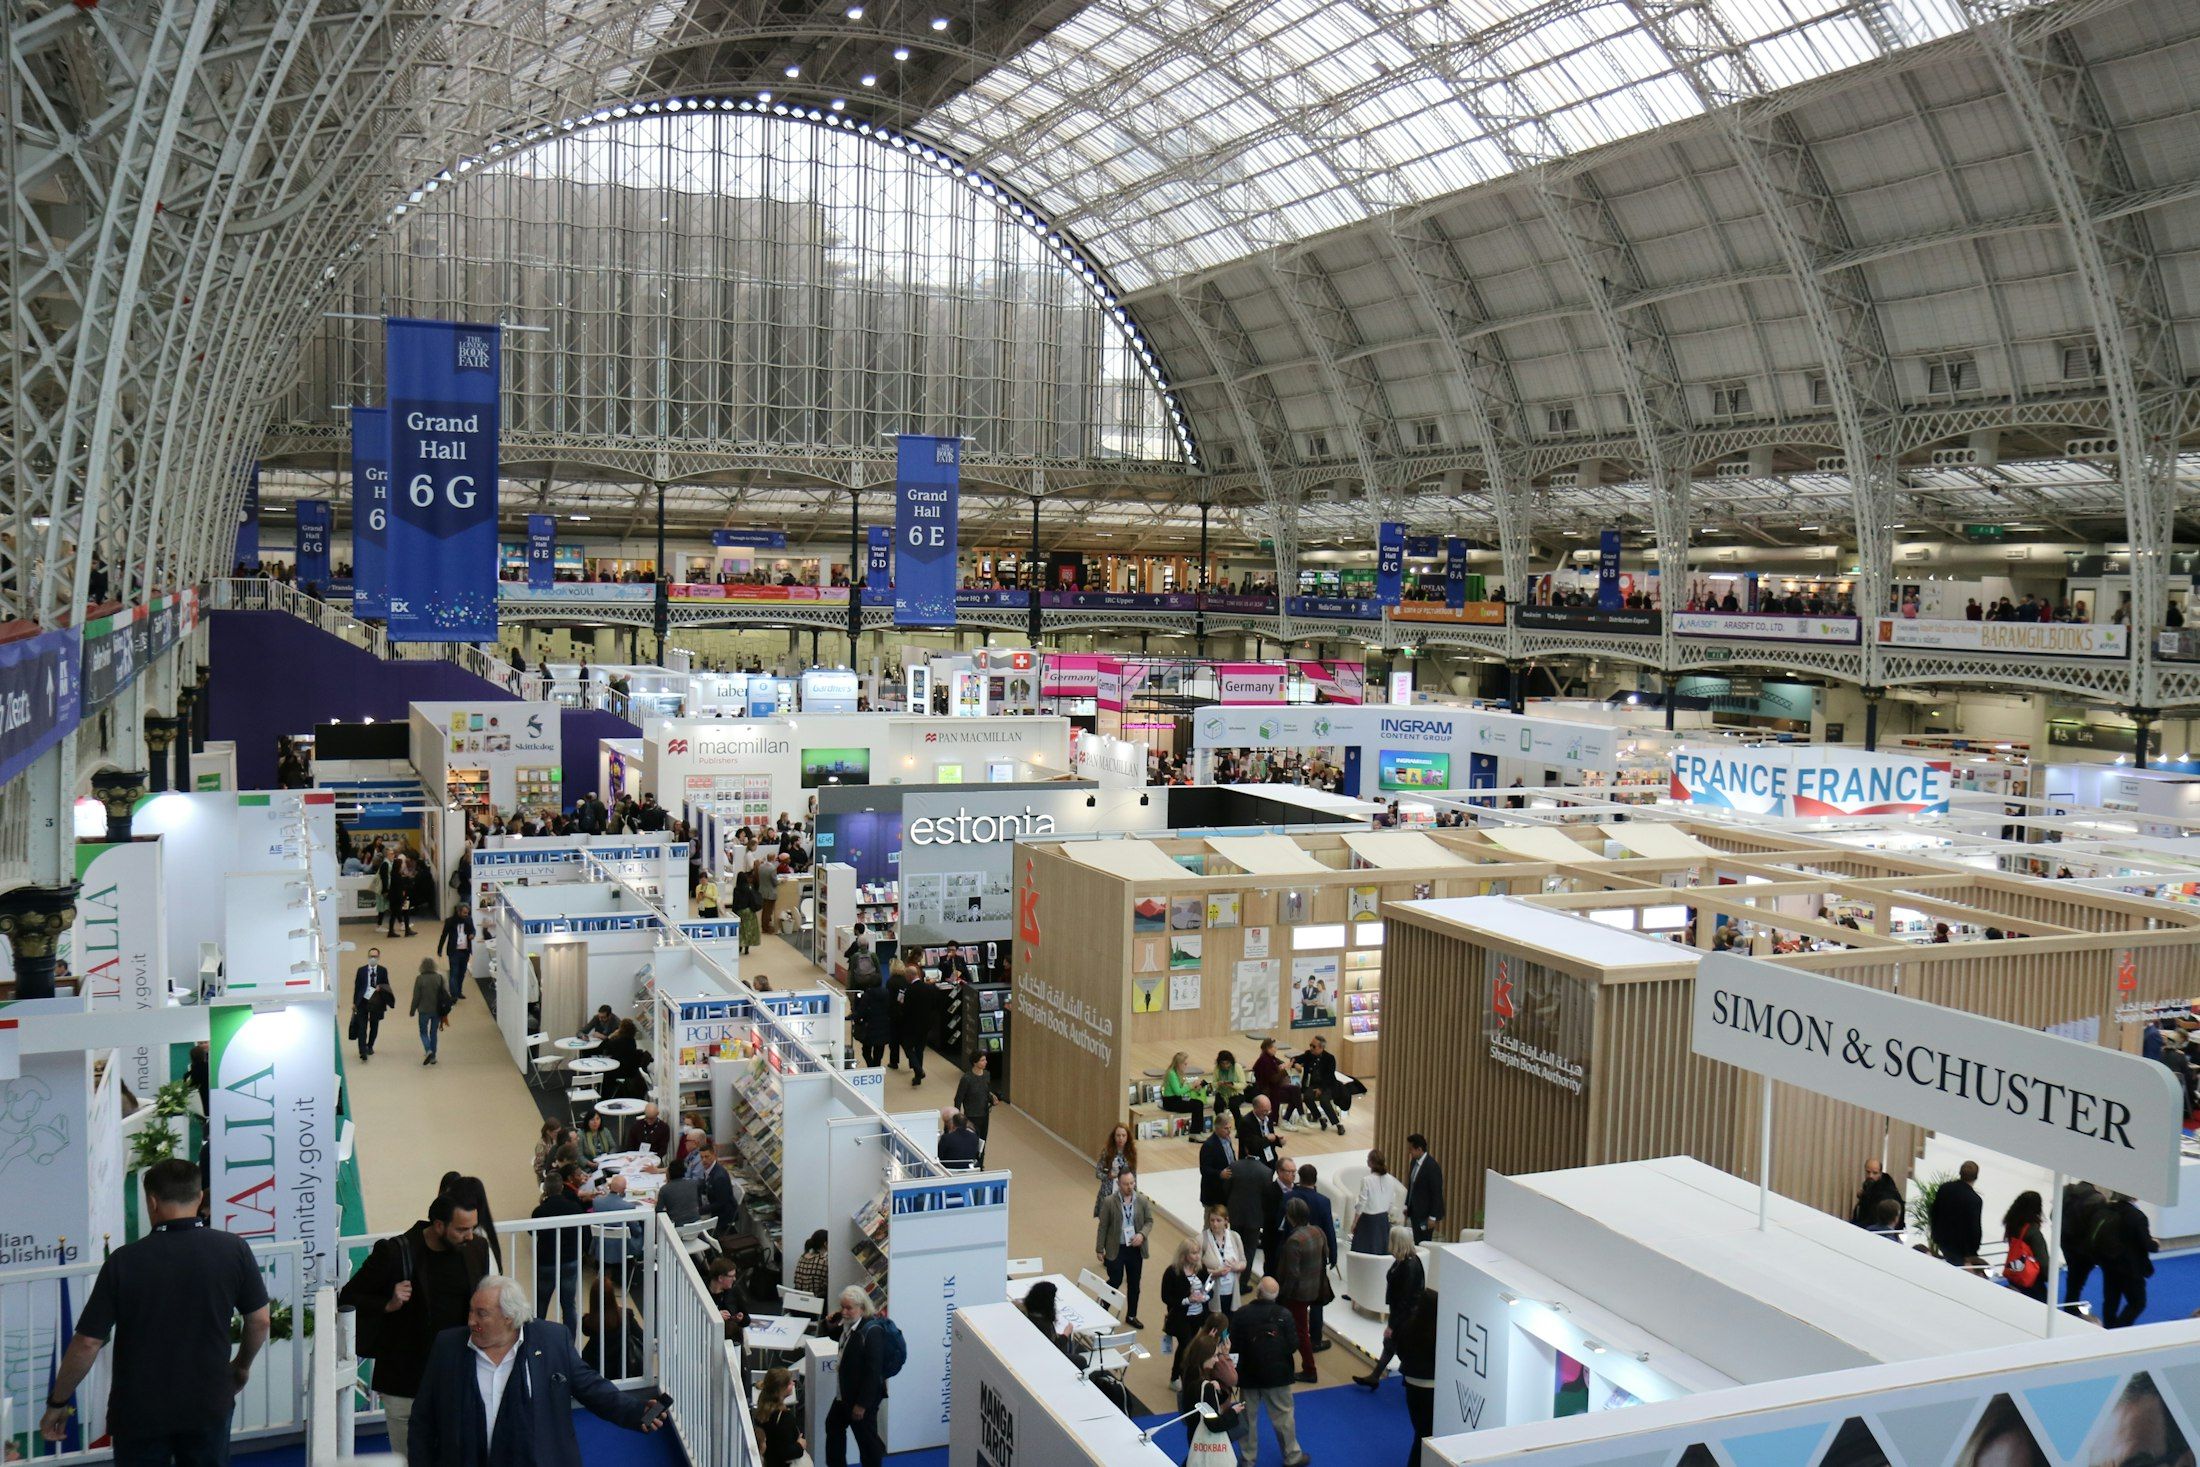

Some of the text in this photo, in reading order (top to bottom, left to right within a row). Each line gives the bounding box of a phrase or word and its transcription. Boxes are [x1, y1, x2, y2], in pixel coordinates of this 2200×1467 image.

[459, 341, 490, 350] LONDON
[458, 347, 490, 359] BOOK
[458, 356, 490, 368] FAIR
[407, 412, 479, 433] Grand
[420, 440, 467, 460] Hall
[409, 474, 477, 509] 6 G
[908, 489, 948, 502] Grand
[914, 506, 941, 518] Hall
[908, 526, 945, 546] 6 E
[302, 542, 323, 552] 6 G
[533, 549, 549, 559] 6 E
[871, 559, 886, 568] 6 D
[1382, 562, 1398, 572] 6 C
[2103, 561, 2120, 571] Lift
[1449, 571, 1456, 579] 6
[1602, 568, 1608, 577] 6
[390, 601, 410, 613] RX
[1723, 621, 1754, 630] ARASOFT
[1770, 624, 1785, 632] LTD.
[1980, 624, 2094, 652] BARAMGILBOOKS
[1050, 672, 1097, 682] Germany
[1226, 680, 1275, 694] Germany
[1381, 719, 1453, 734] INGRAM
[939, 732, 1022, 743] PAN MACMILLAN
[1380, 733, 1452, 742] CONTENT GROUP
[2077, 732, 2094, 743] Lift
[515, 743, 555, 751] Skittledog
[699, 737, 790, 754] macmillan
[1085, 751, 1139, 777] PAN MACMILLAN
[1675, 754, 1940, 802] FRANCE FRANCE
[910, 805, 1056, 845] estonia
[484, 866, 556, 877] LLEWELLYN
[686, 1025, 733, 1041] PGUK
[1018, 993, 1112, 1068] Sharjah Book Authority
[1490, 1045, 1582, 1096] Sharjah Book Authority
[1712, 989, 2136, 1150] SIMON & SCHUSTER
[853, 1074, 883, 1086] 6E30
[944, 1274, 956, 1300] UK
[980, 1380, 1014, 1447] MANGA
[980, 1411, 1014, 1467] TAROT
[1194, 1443, 1227, 1452] BOOKBAR
